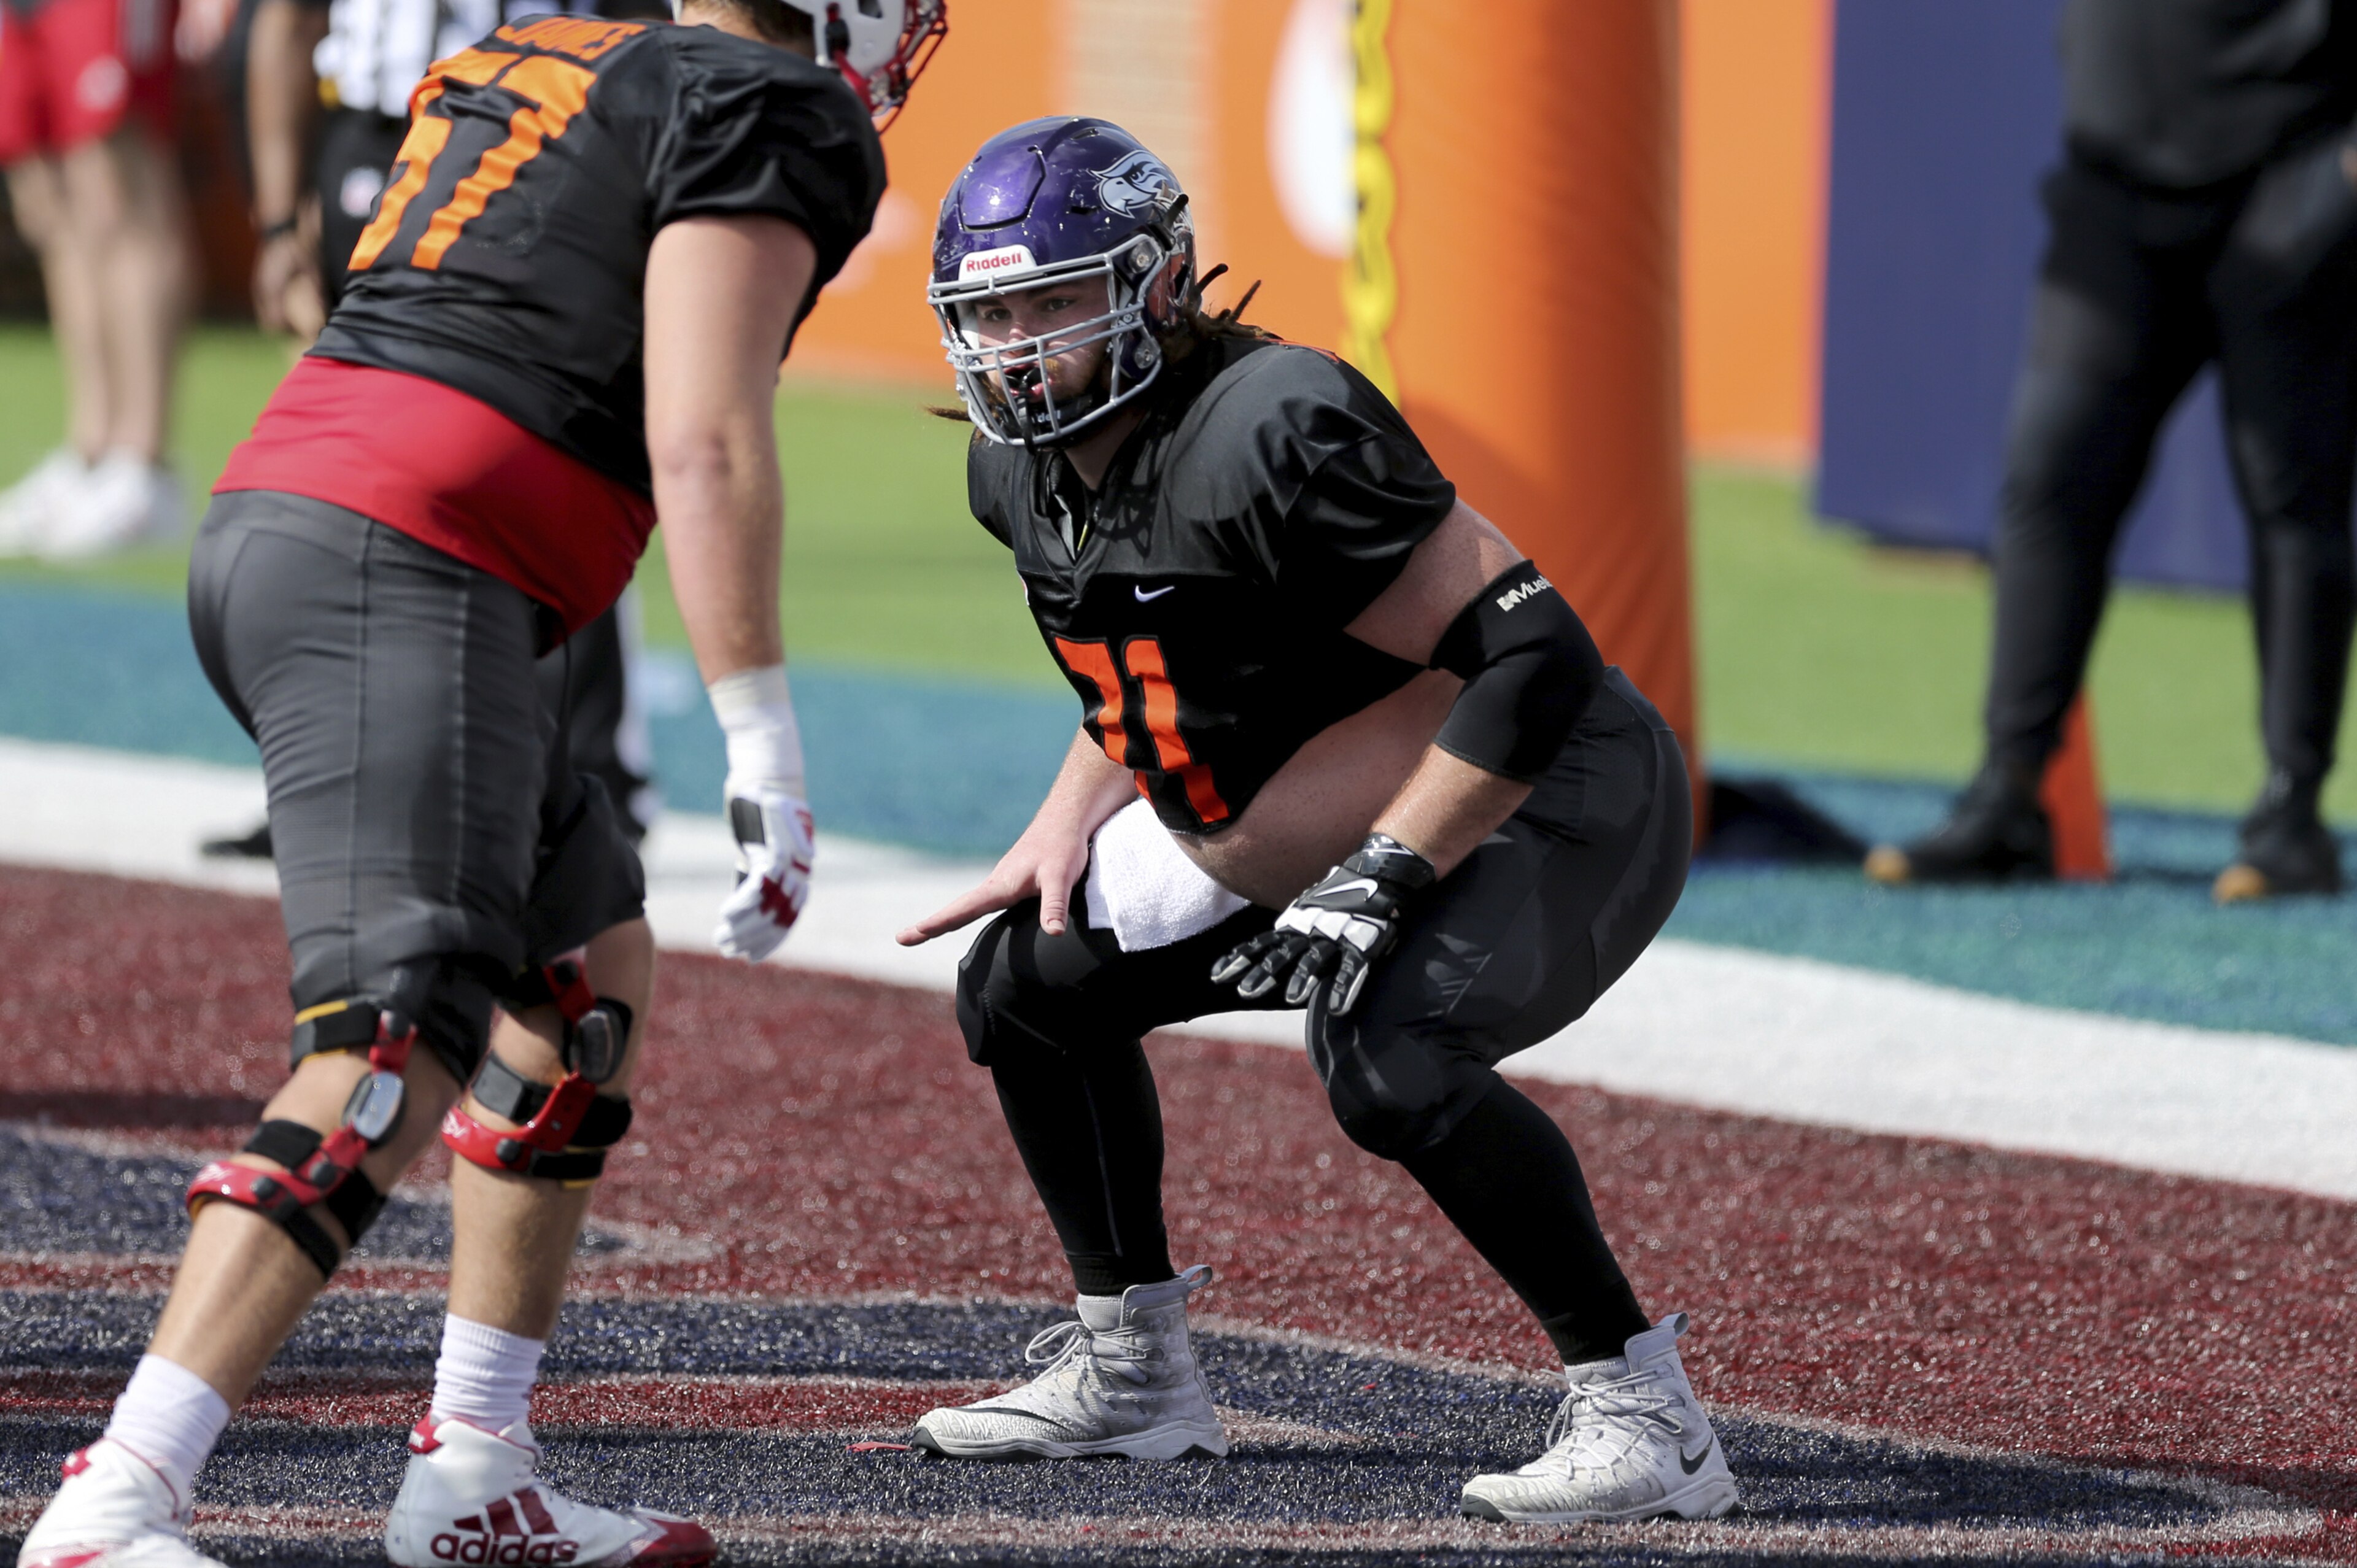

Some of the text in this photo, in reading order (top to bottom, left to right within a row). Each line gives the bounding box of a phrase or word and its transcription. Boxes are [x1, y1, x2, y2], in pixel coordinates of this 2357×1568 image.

[966, 252, 1022, 272] Riddell
[1055, 636, 1229, 824] 71
[430, 1532, 580, 1565] adidas
